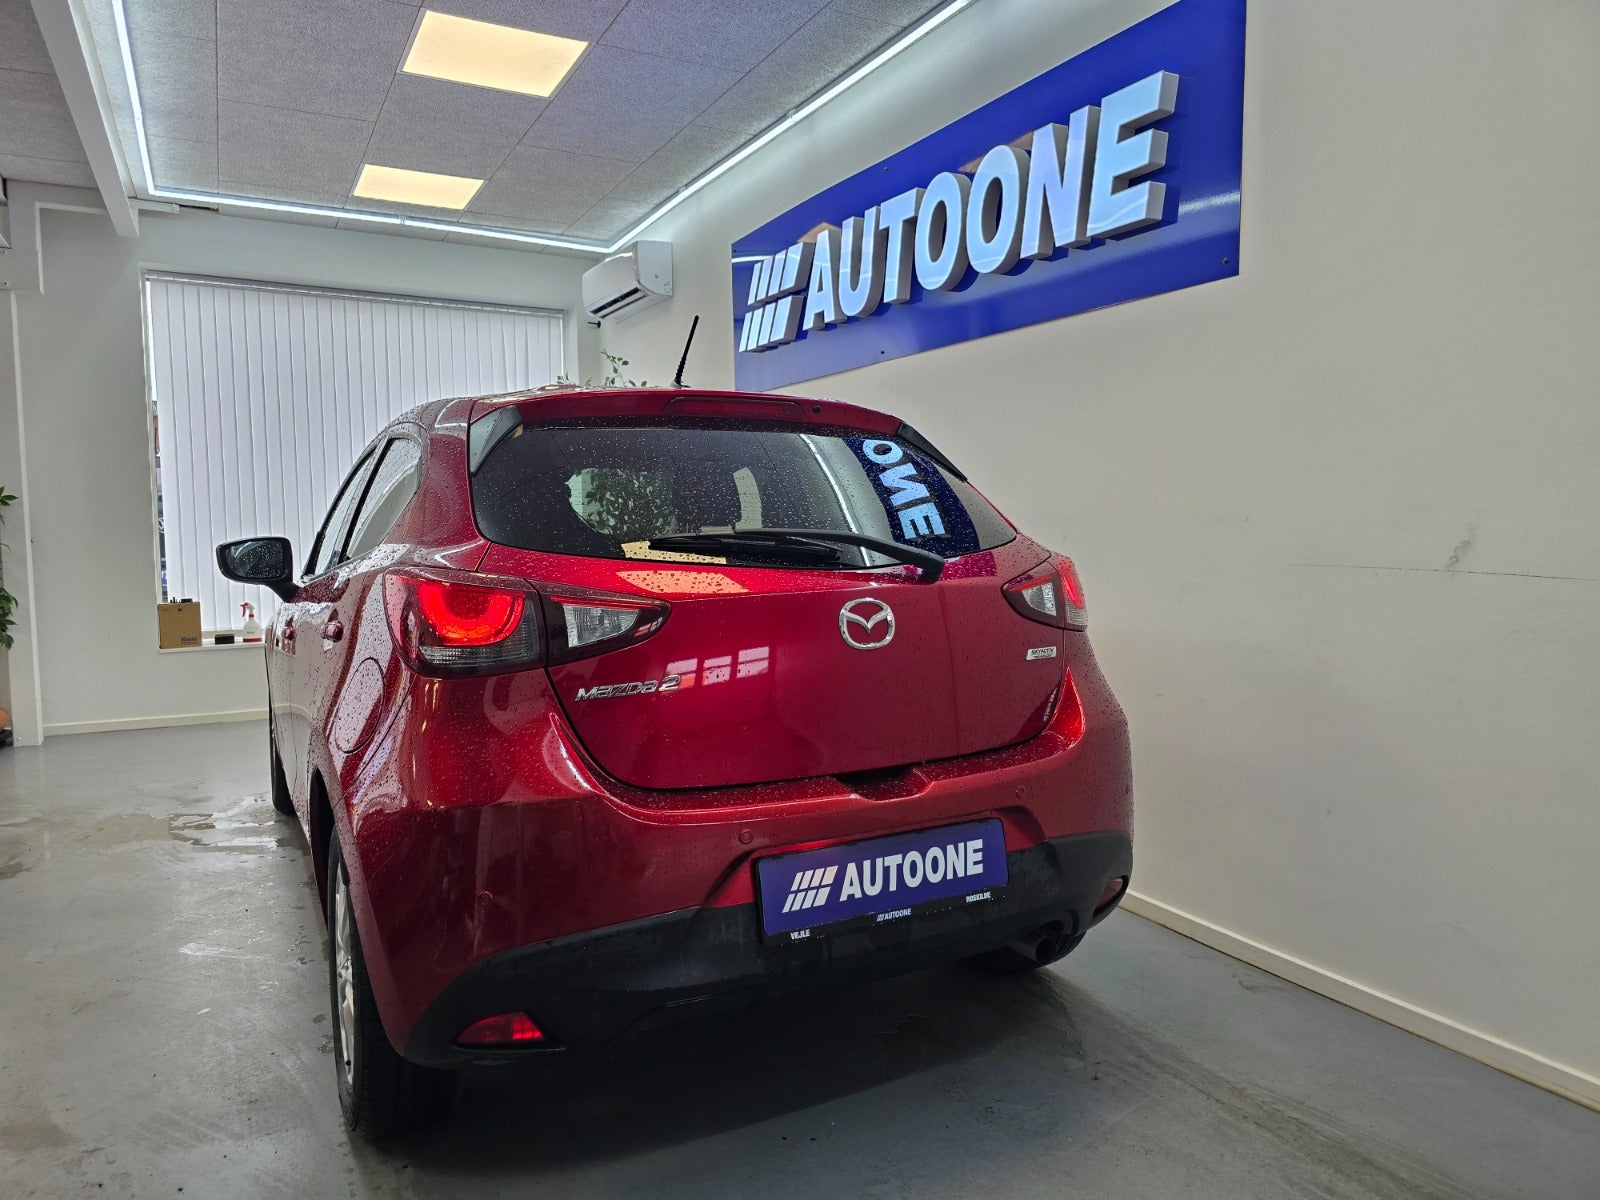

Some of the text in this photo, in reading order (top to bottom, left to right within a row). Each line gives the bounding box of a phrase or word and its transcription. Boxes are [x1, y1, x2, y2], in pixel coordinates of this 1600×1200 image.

[803, 70, 1178, 331] AUTOONE
[839, 839, 984, 902] AUTOONE
[965, 891, 992, 904] ROSKILDE
[884, 907, 912, 920] AUTOONE
[790, 929, 811, 941] VEJLE
